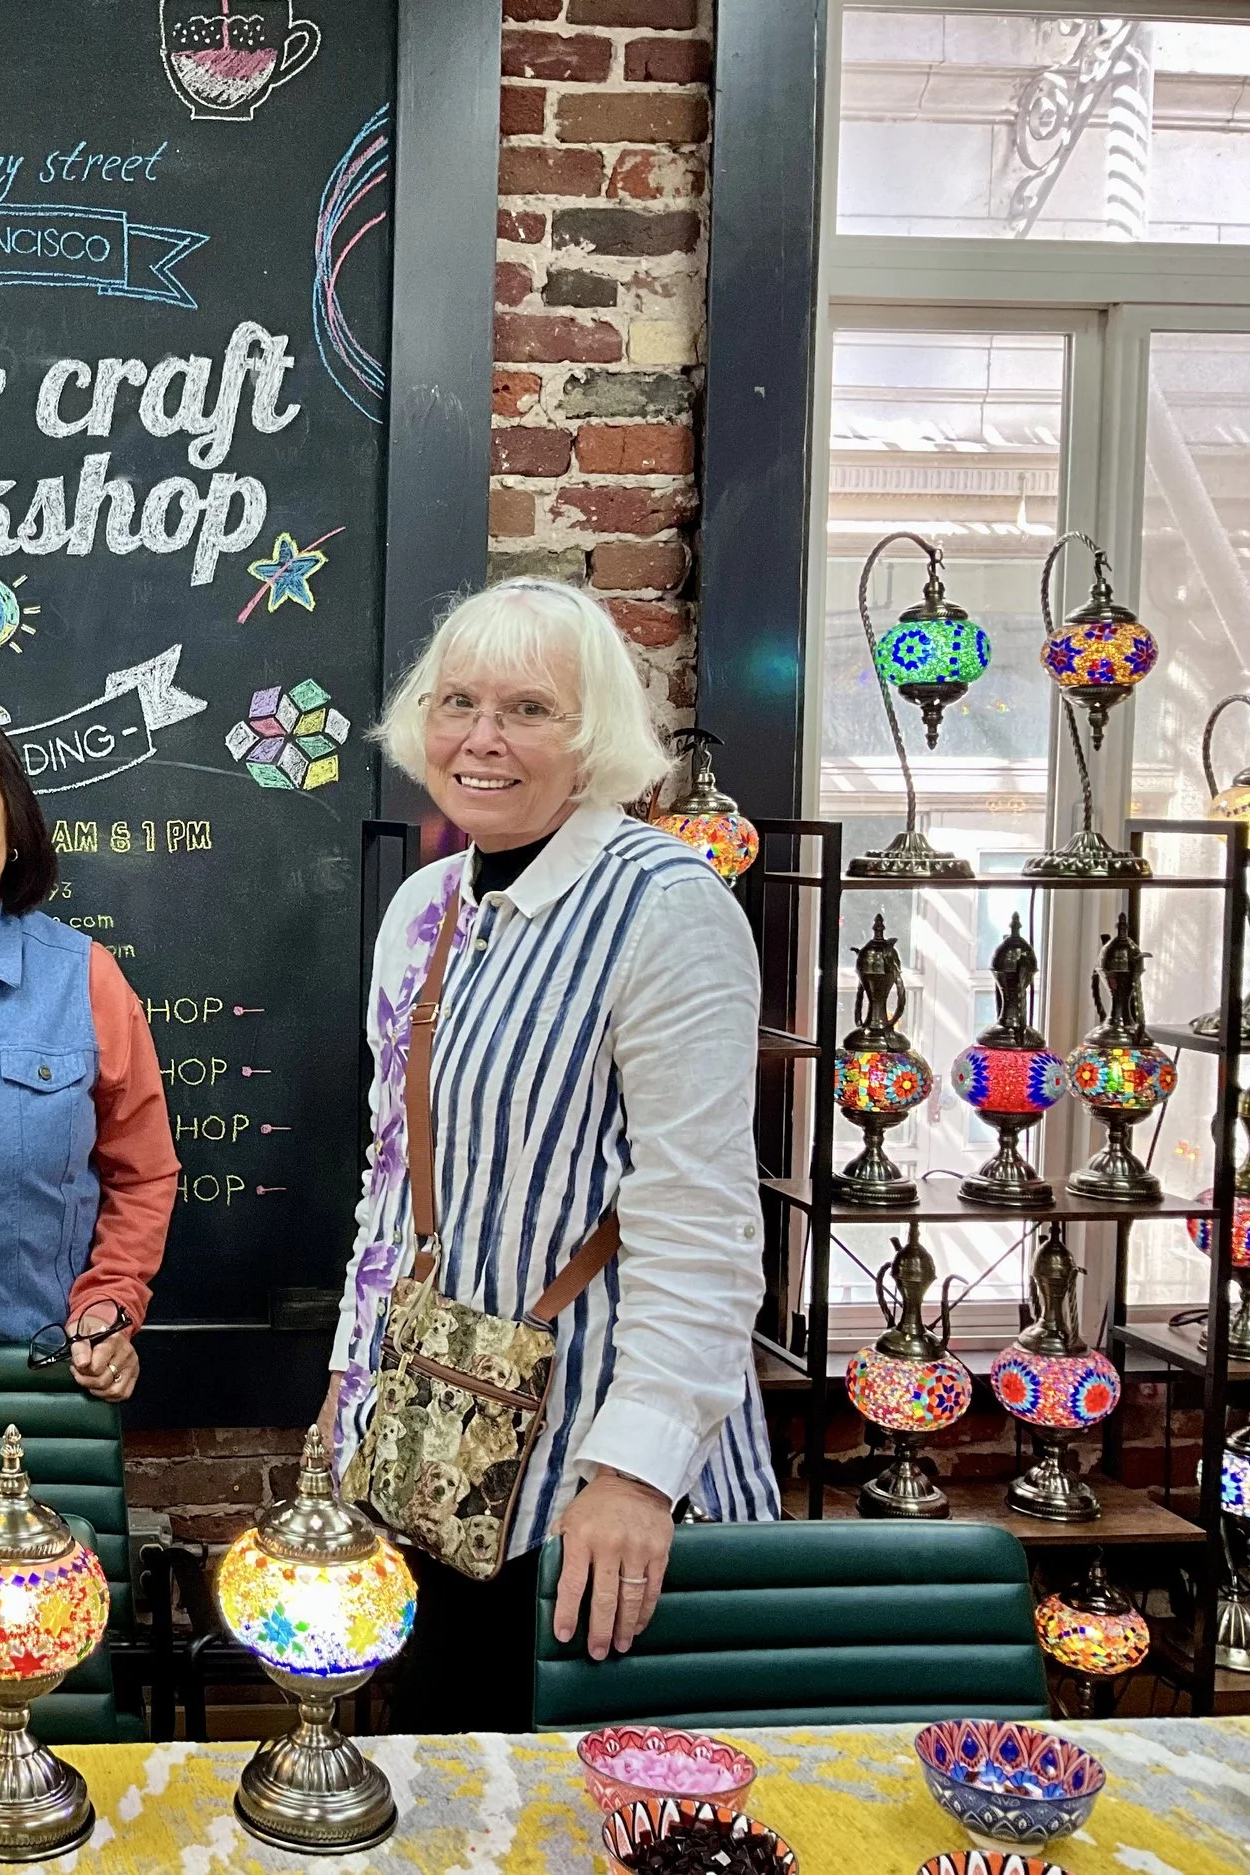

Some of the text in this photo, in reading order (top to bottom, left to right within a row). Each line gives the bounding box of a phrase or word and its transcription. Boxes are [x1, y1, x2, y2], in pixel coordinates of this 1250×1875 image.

[39, 140, 168, 183] street
[34, 321, 301, 469] craft
[23, 724, 115, 776] DING
[51, 820, 98, 853] AM
[141, 820, 155, 852] 1
[166, 820, 212, 853] PM
[139, 997, 223, 1024] HOP
[160, 1057, 228, 1086] HOP
[175, 1114, 250, 1143] HOP
[177, 1174, 245, 1206] HOP
